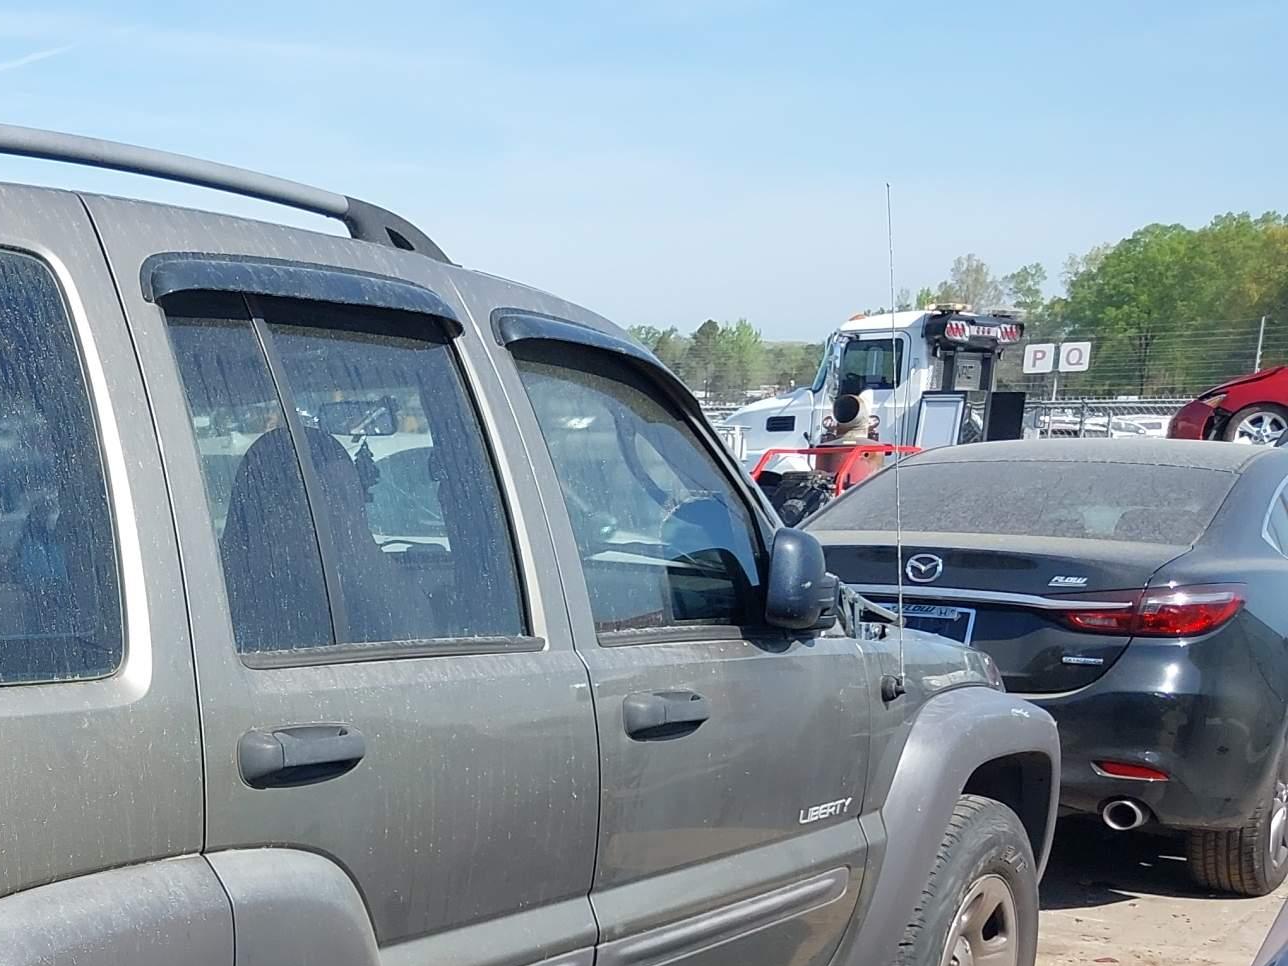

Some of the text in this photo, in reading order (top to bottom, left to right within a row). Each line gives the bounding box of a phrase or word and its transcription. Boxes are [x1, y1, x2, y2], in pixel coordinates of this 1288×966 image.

[1031, 349, 1046, 369] P
[1065, 347, 1084, 366] Q
[799, 796, 853, 825] LIBERTY
